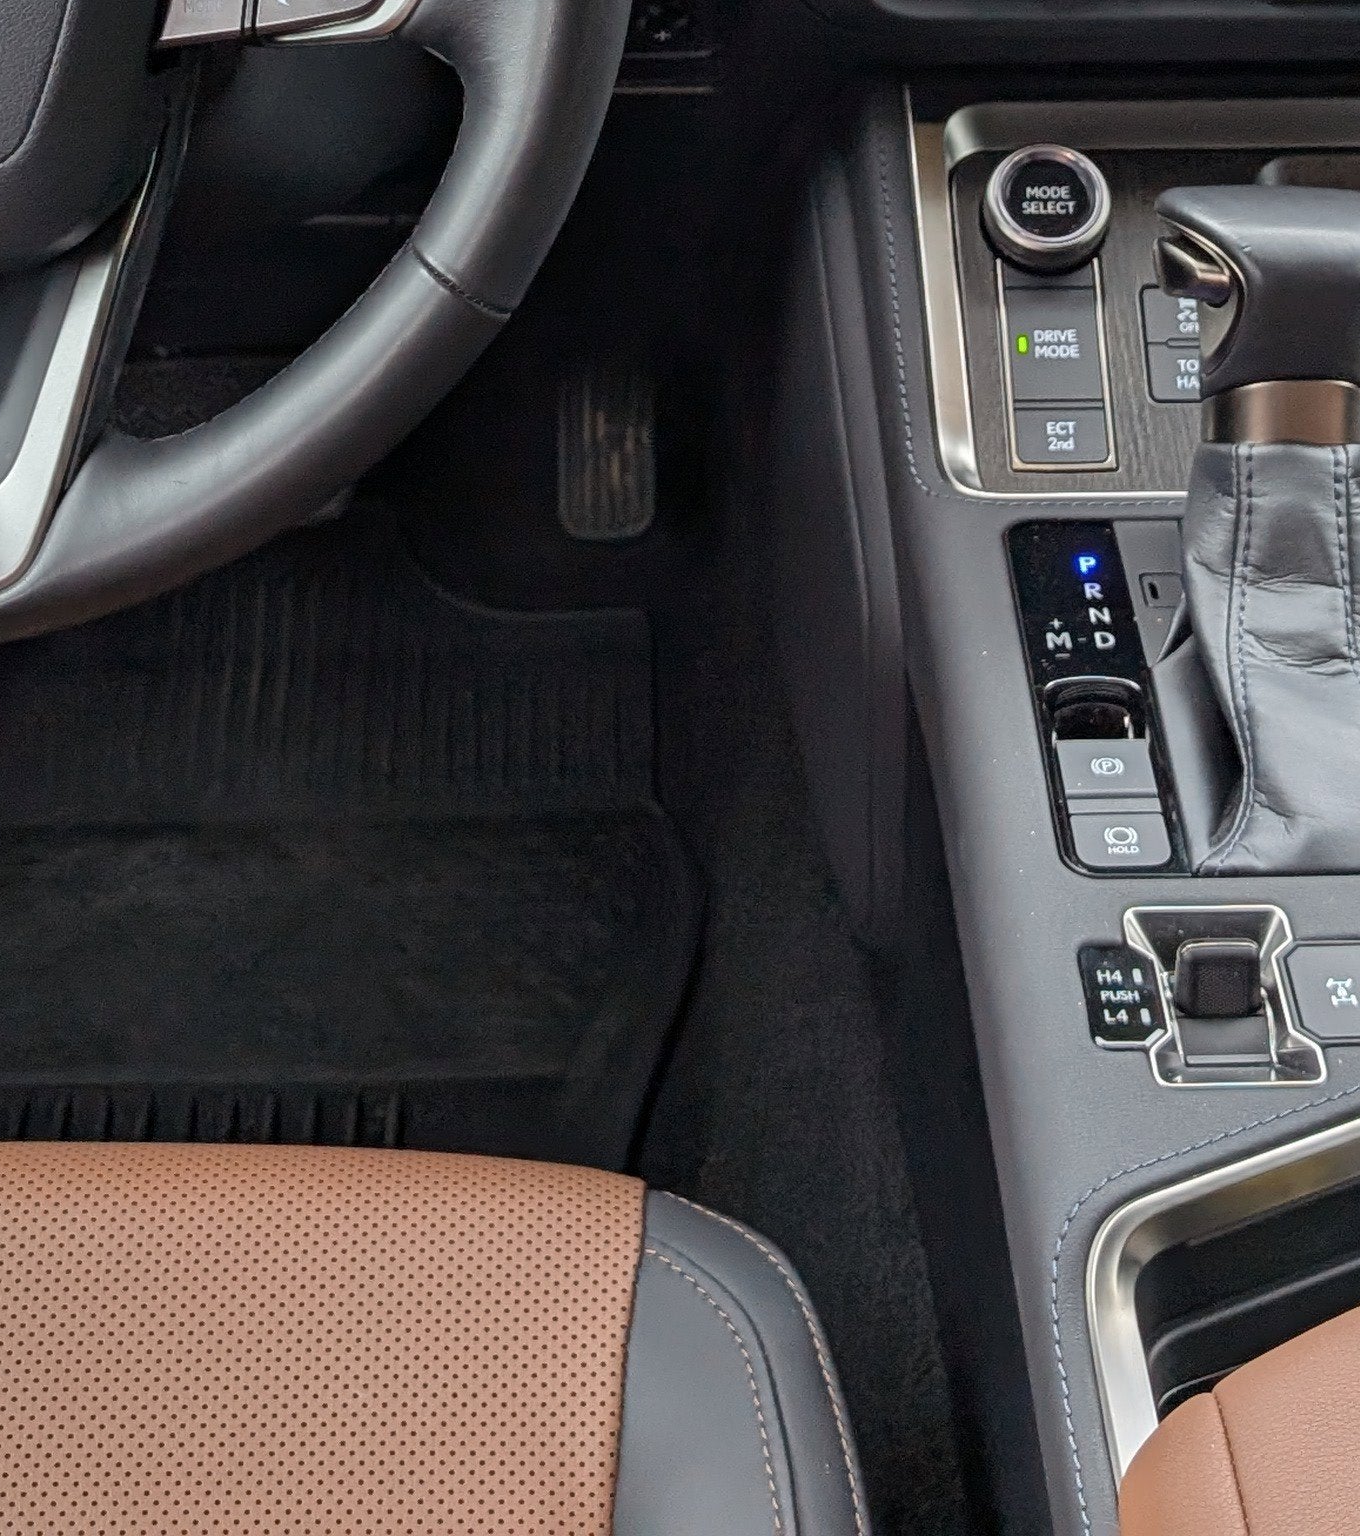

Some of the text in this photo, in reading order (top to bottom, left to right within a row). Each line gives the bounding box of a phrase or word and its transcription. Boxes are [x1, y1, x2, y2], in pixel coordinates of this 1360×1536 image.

[1025, 185, 1071, 199] MODE
[1021, 200, 1077, 215] SELECT
[1034, 328, 1077, 343] DRIVE
[1035, 343, 1080, 358] MODE
[1177, 358, 1200, 374] TO
[1176, 375, 1200, 390] HA
[1046, 421, 1076, 436] ECT
[1047, 436, 1074, 452] 2nd
[1078, 556, 1096, 575] P
[1083, 582, 1104, 600] R
[1088, 606, 1112, 625] N
[1045, 630, 1116, 651] M D
[1107, 845, 1140, 855] HOLD
[1096, 968, 1123, 985] H4
[1100, 989, 1141, 1004] PUSH
[1103, 1008, 1129, 1026] L4
